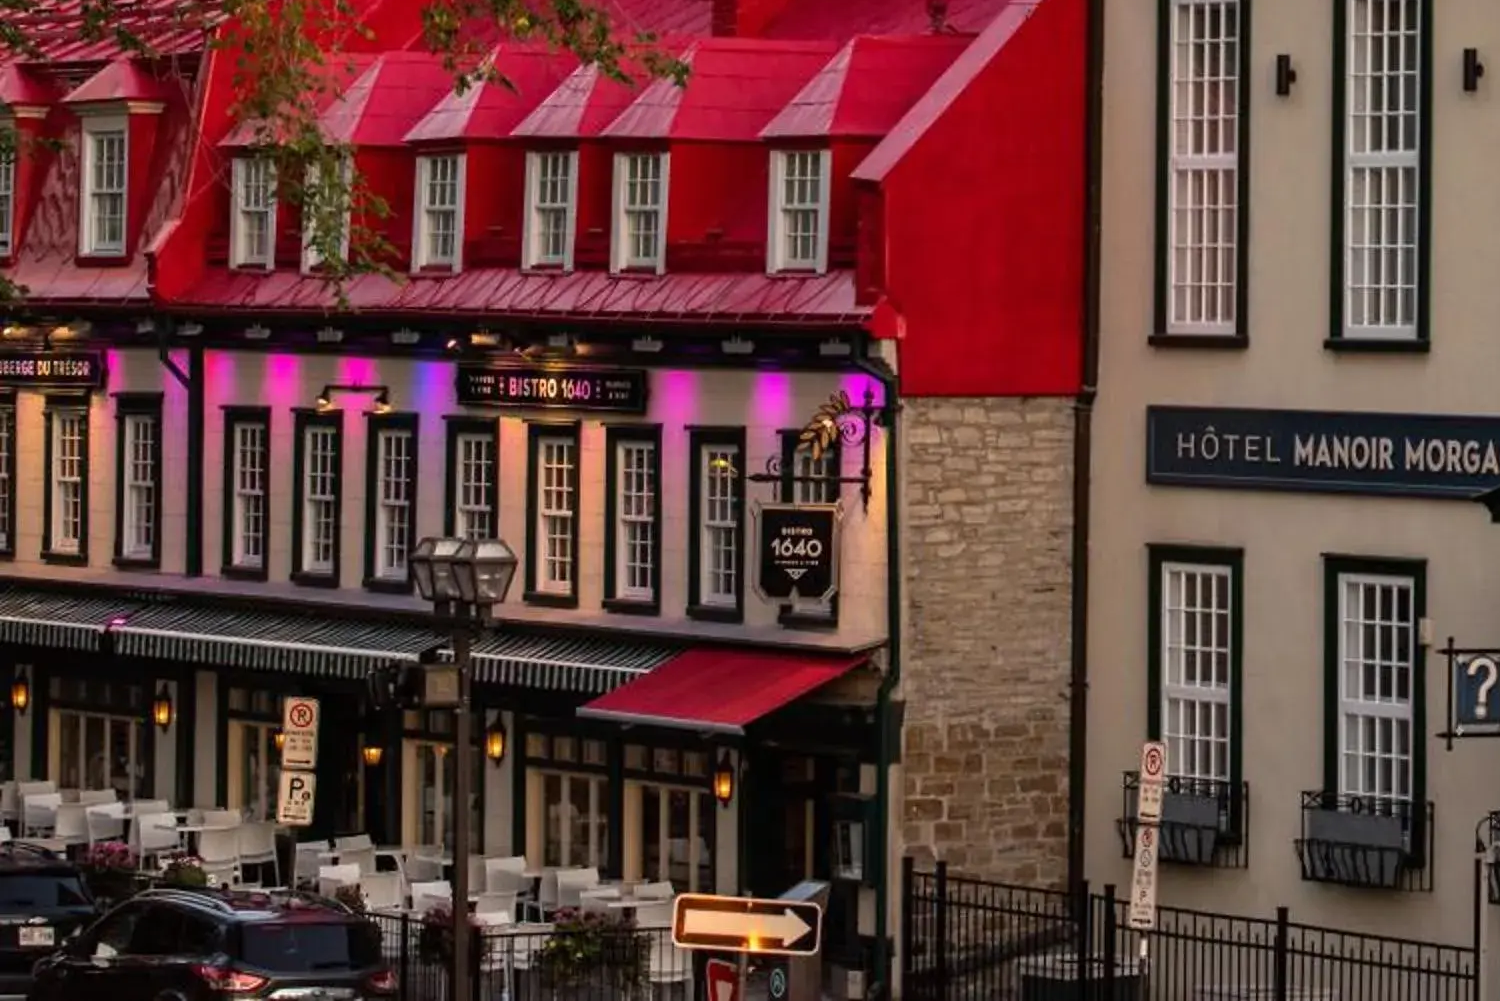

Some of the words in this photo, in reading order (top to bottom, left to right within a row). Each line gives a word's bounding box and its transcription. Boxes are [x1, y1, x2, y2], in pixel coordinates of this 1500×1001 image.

[37, 360, 51, 376] DU
[509, 376, 557, 399] BISTRO
[561, 378, 591, 400] 1640
[1176, 425, 1281, 462] HÔTEL
[1294, 433, 1395, 471] MANOIR
[771, 537, 823, 559] 1640
